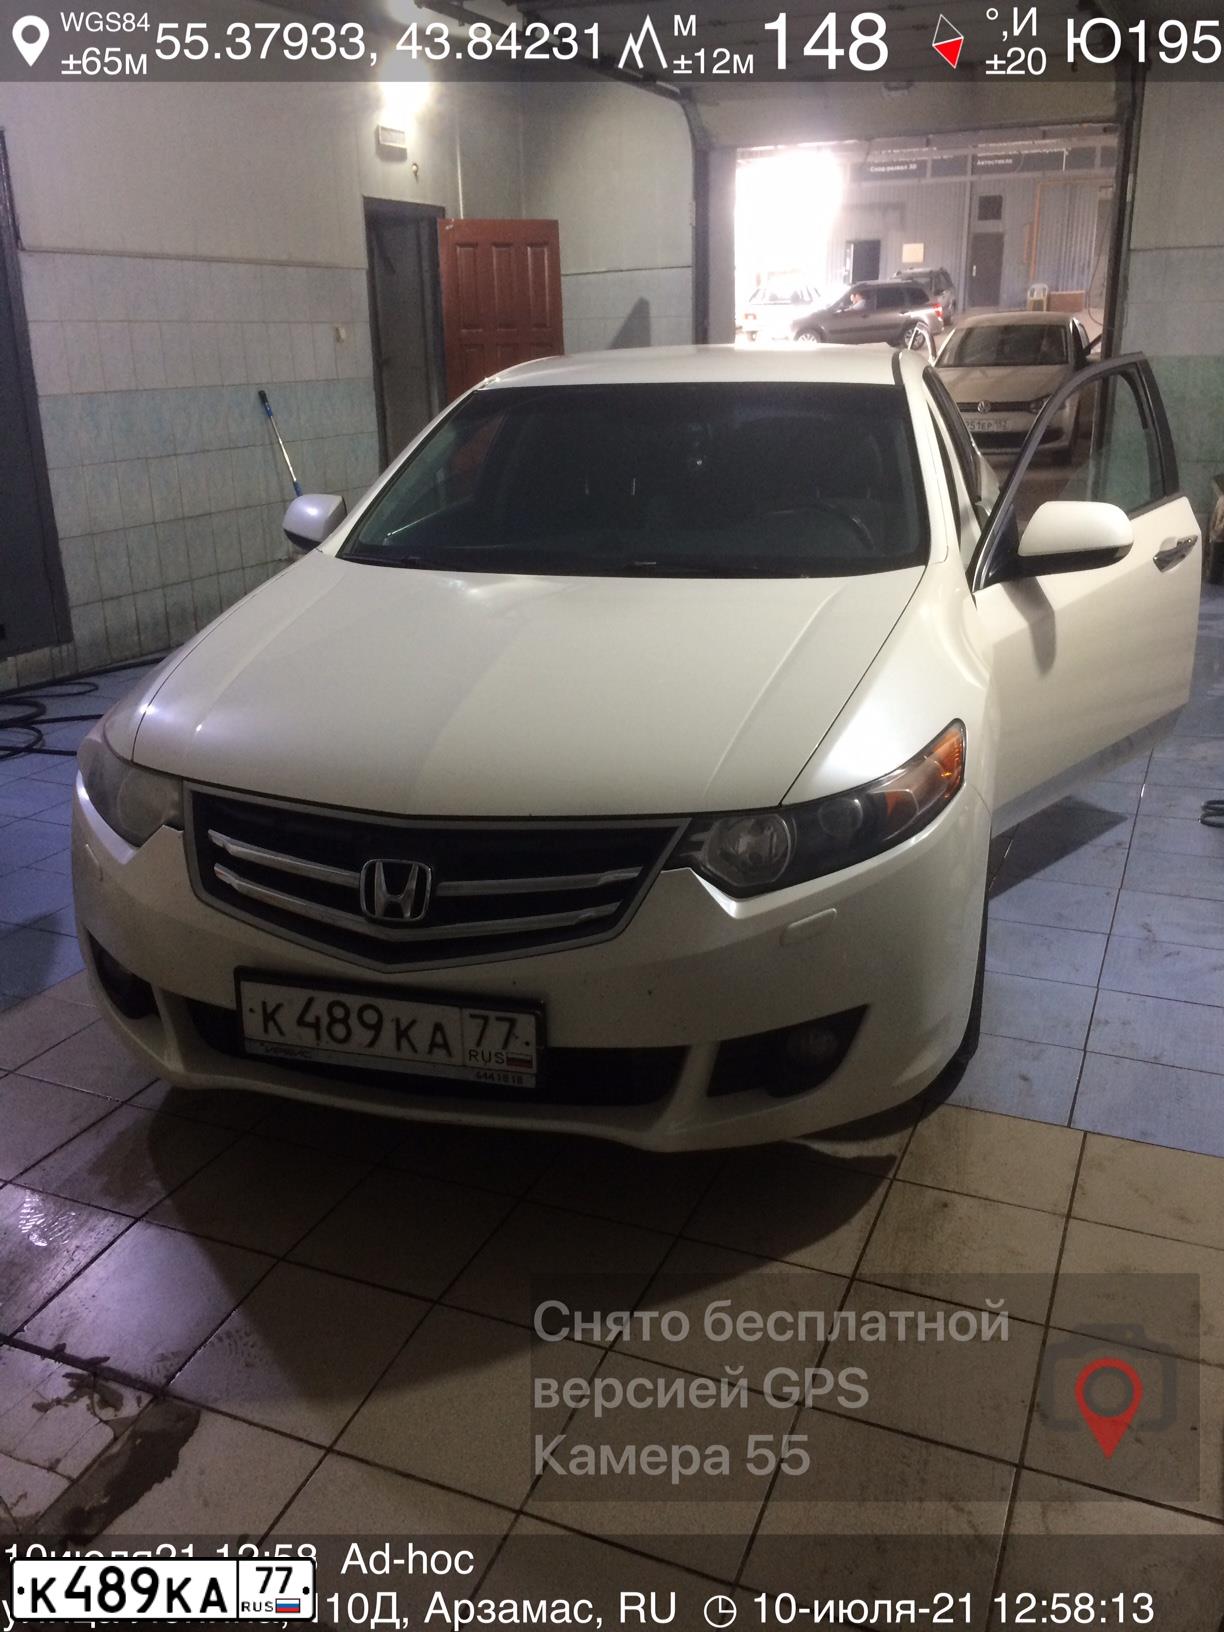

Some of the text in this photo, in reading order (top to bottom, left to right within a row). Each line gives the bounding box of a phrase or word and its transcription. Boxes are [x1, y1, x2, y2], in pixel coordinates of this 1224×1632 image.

[261, 996, 517, 1058] К489КА 77
[469, 1049, 505, 1065] RUS
